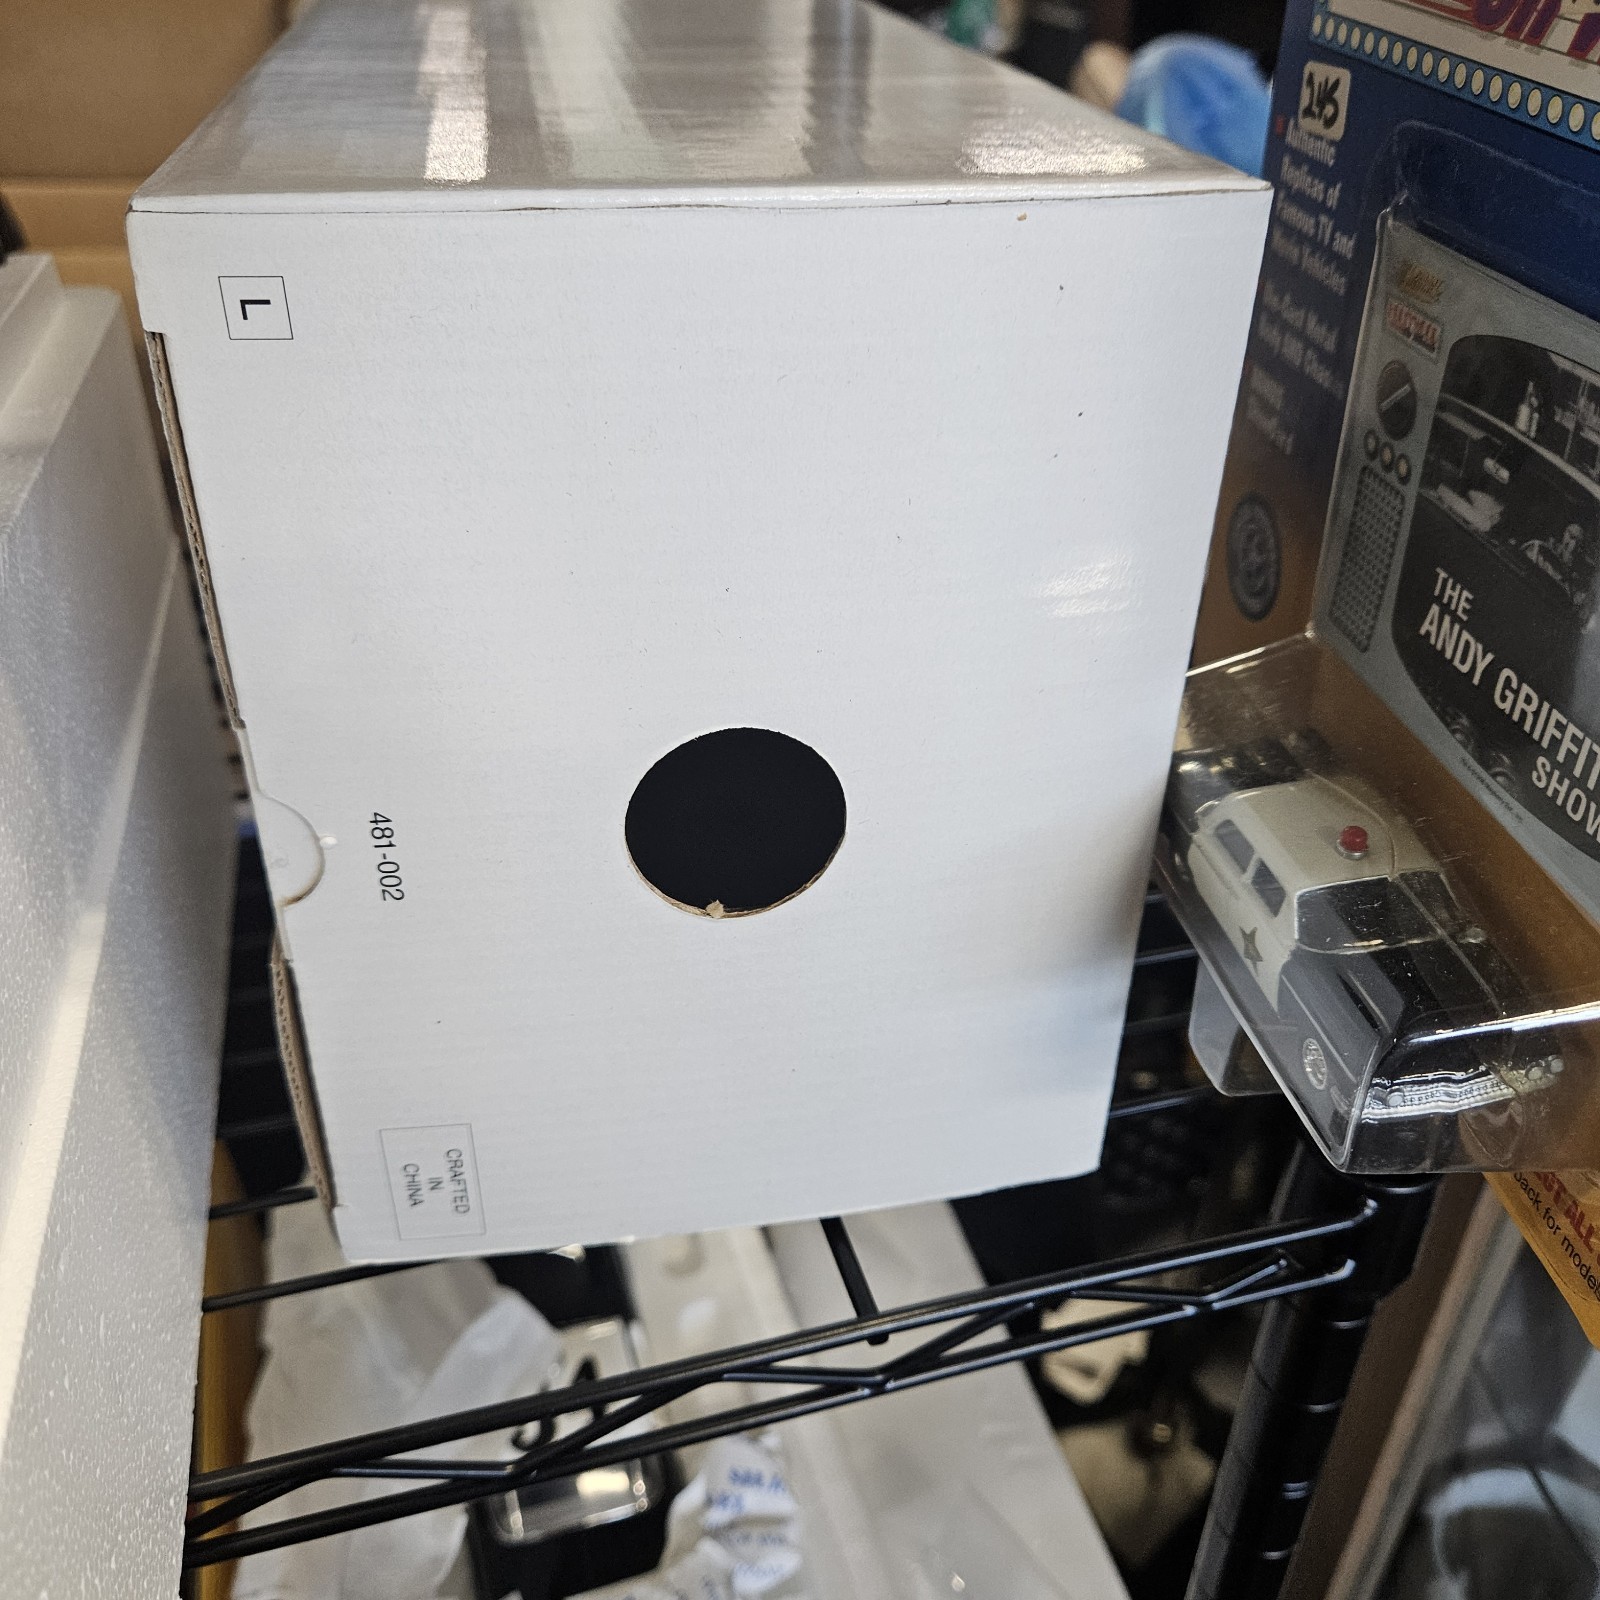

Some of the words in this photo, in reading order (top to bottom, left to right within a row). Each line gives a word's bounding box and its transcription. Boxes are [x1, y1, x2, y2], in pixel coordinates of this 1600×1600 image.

[240, 299, 271, 321] L
[1434, 567, 1474, 622] THE
[1418, 602, 1495, 686] ANDY
[369, 811, 405, 902] 481-002
[403, 1163, 425, 1208] CHINA
[428, 1176, 445, 1191] IN
[446, 1148, 471, 1214] CRAFTED
[1542, 1207, 1561, 1235] for
[1564, 1199, 1595, 1254] ALL
